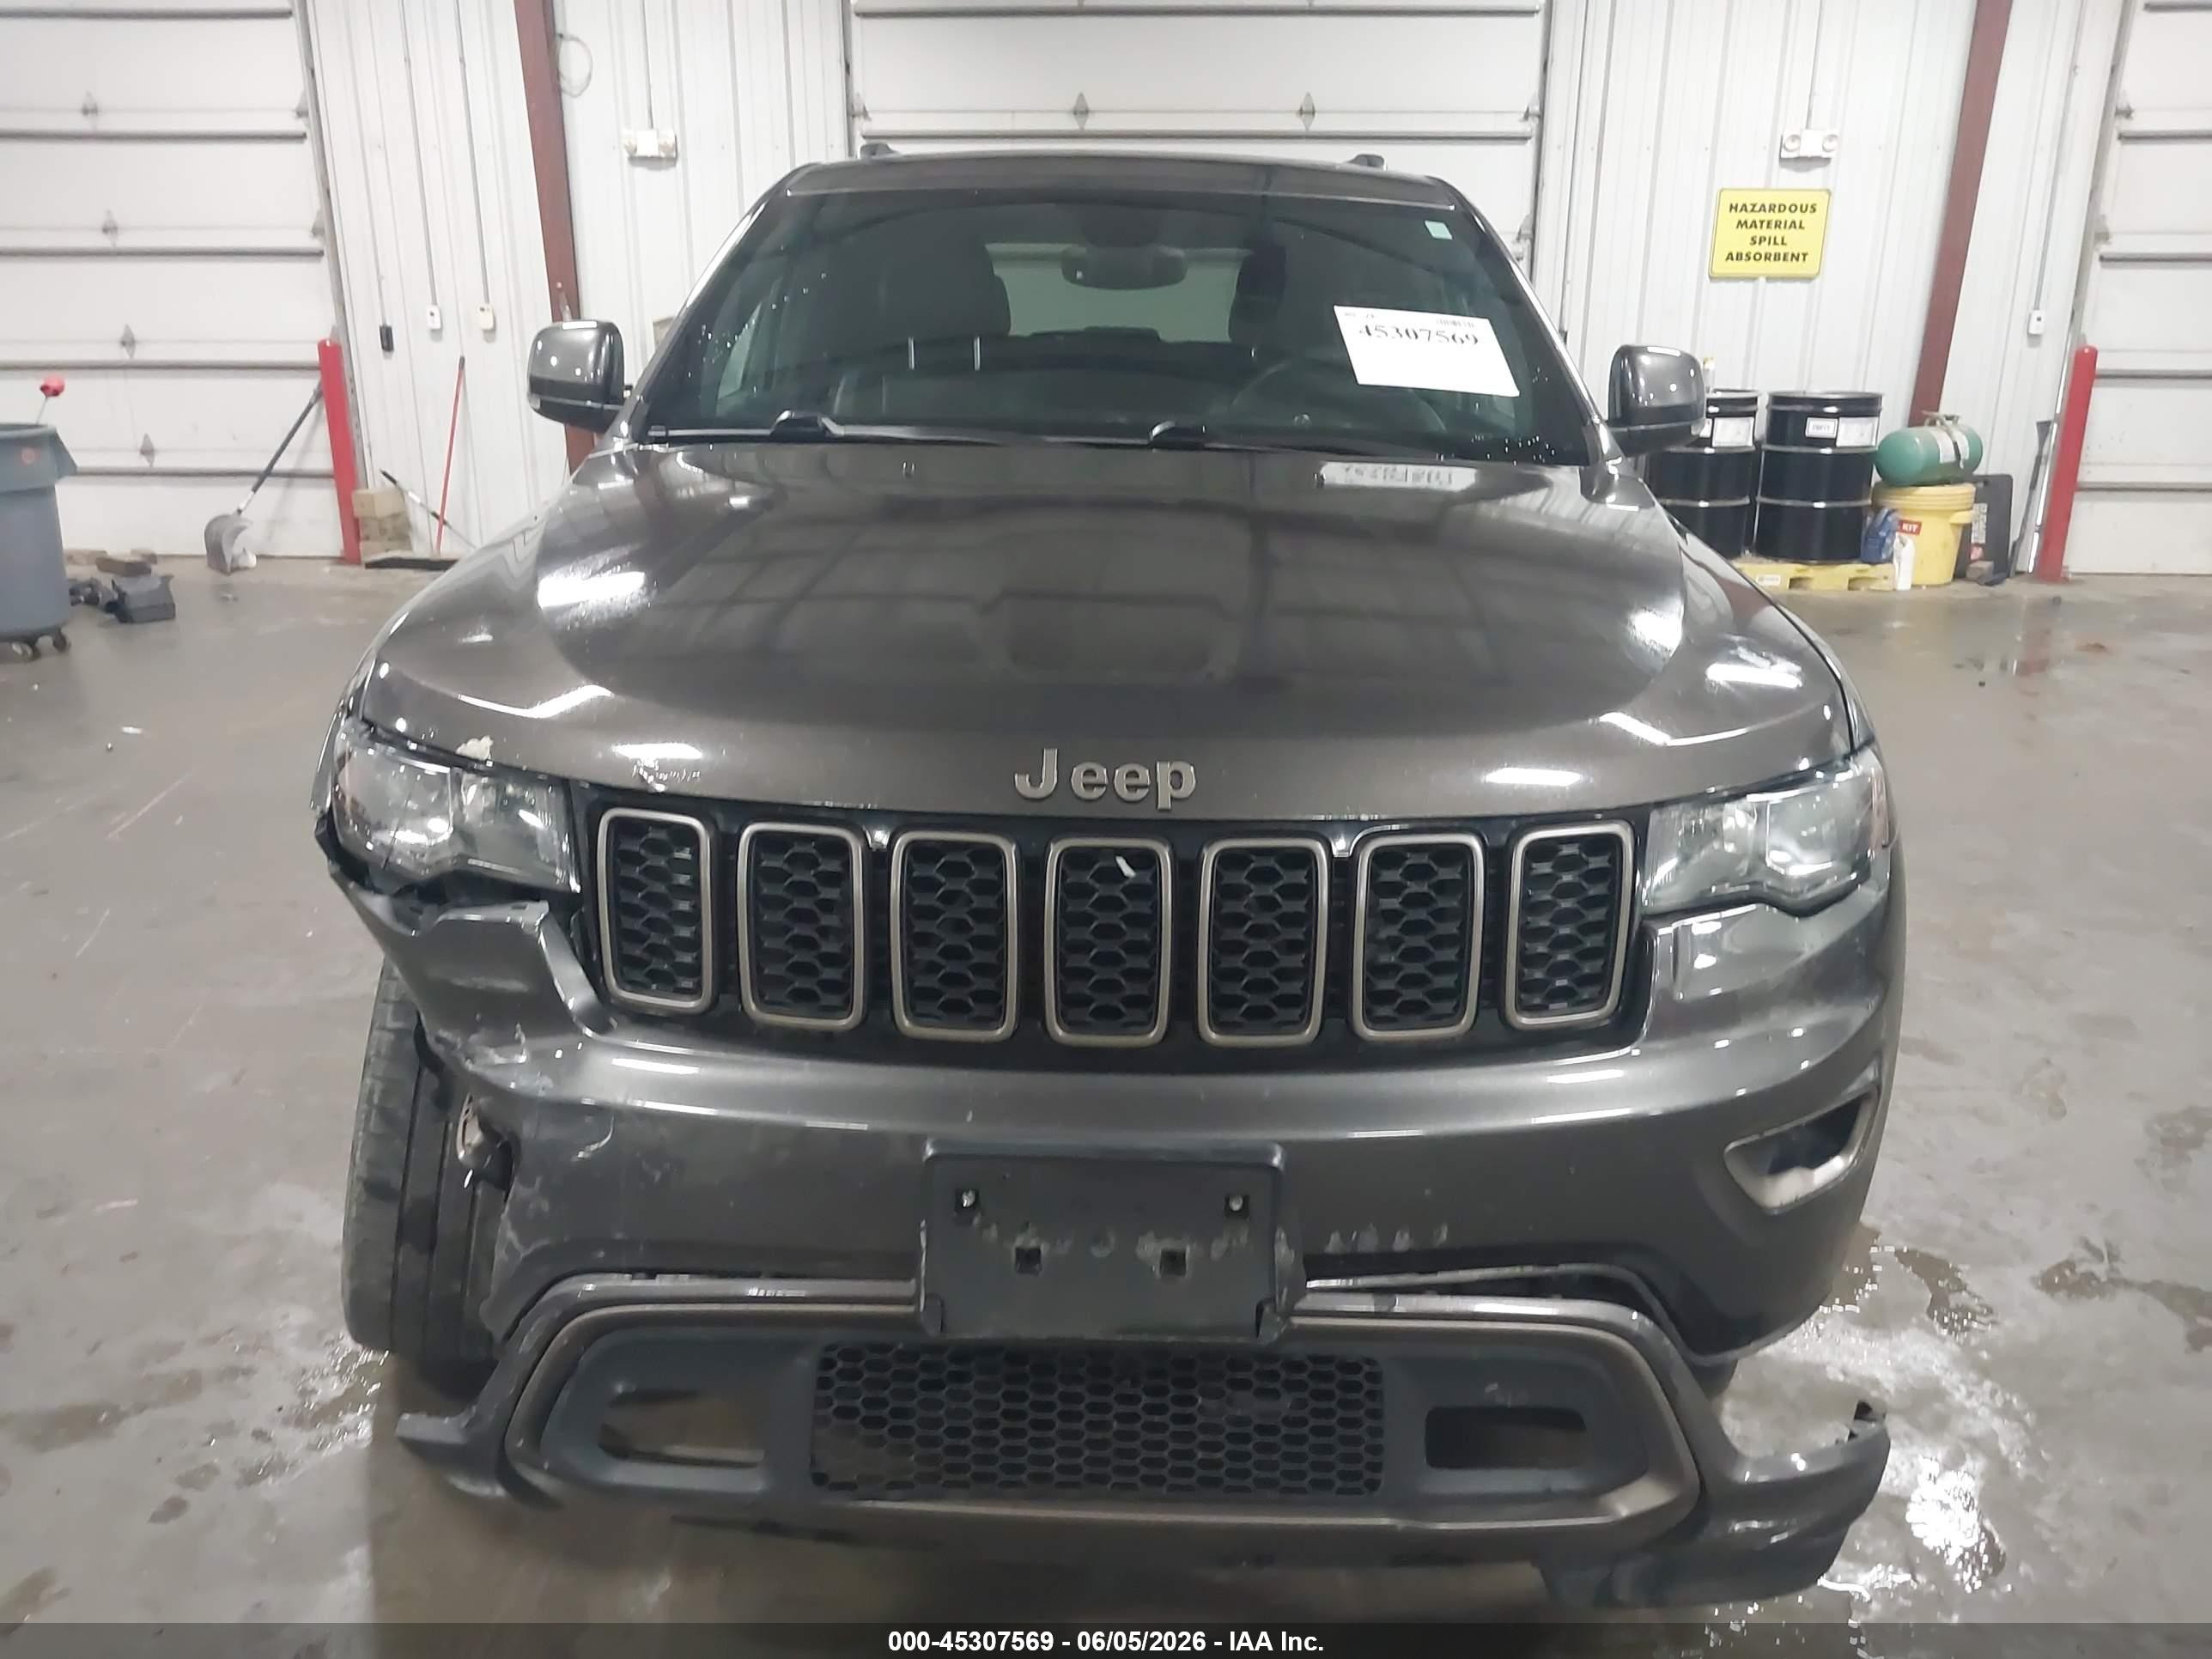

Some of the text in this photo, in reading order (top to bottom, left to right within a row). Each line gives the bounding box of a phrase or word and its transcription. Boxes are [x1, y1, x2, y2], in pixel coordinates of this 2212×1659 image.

[1729, 203, 1817, 214] HAZARDOUS
[1735, 219, 1806, 230] MATERIAL
[1749, 235, 1788, 246] SPILL
[1725, 252, 1808, 263] ABSORBENT
[1359, 324, 1479, 345] 45307569
[1902, 522, 1918, 533] KIT
[1014, 748, 1197, 811] Jeep
